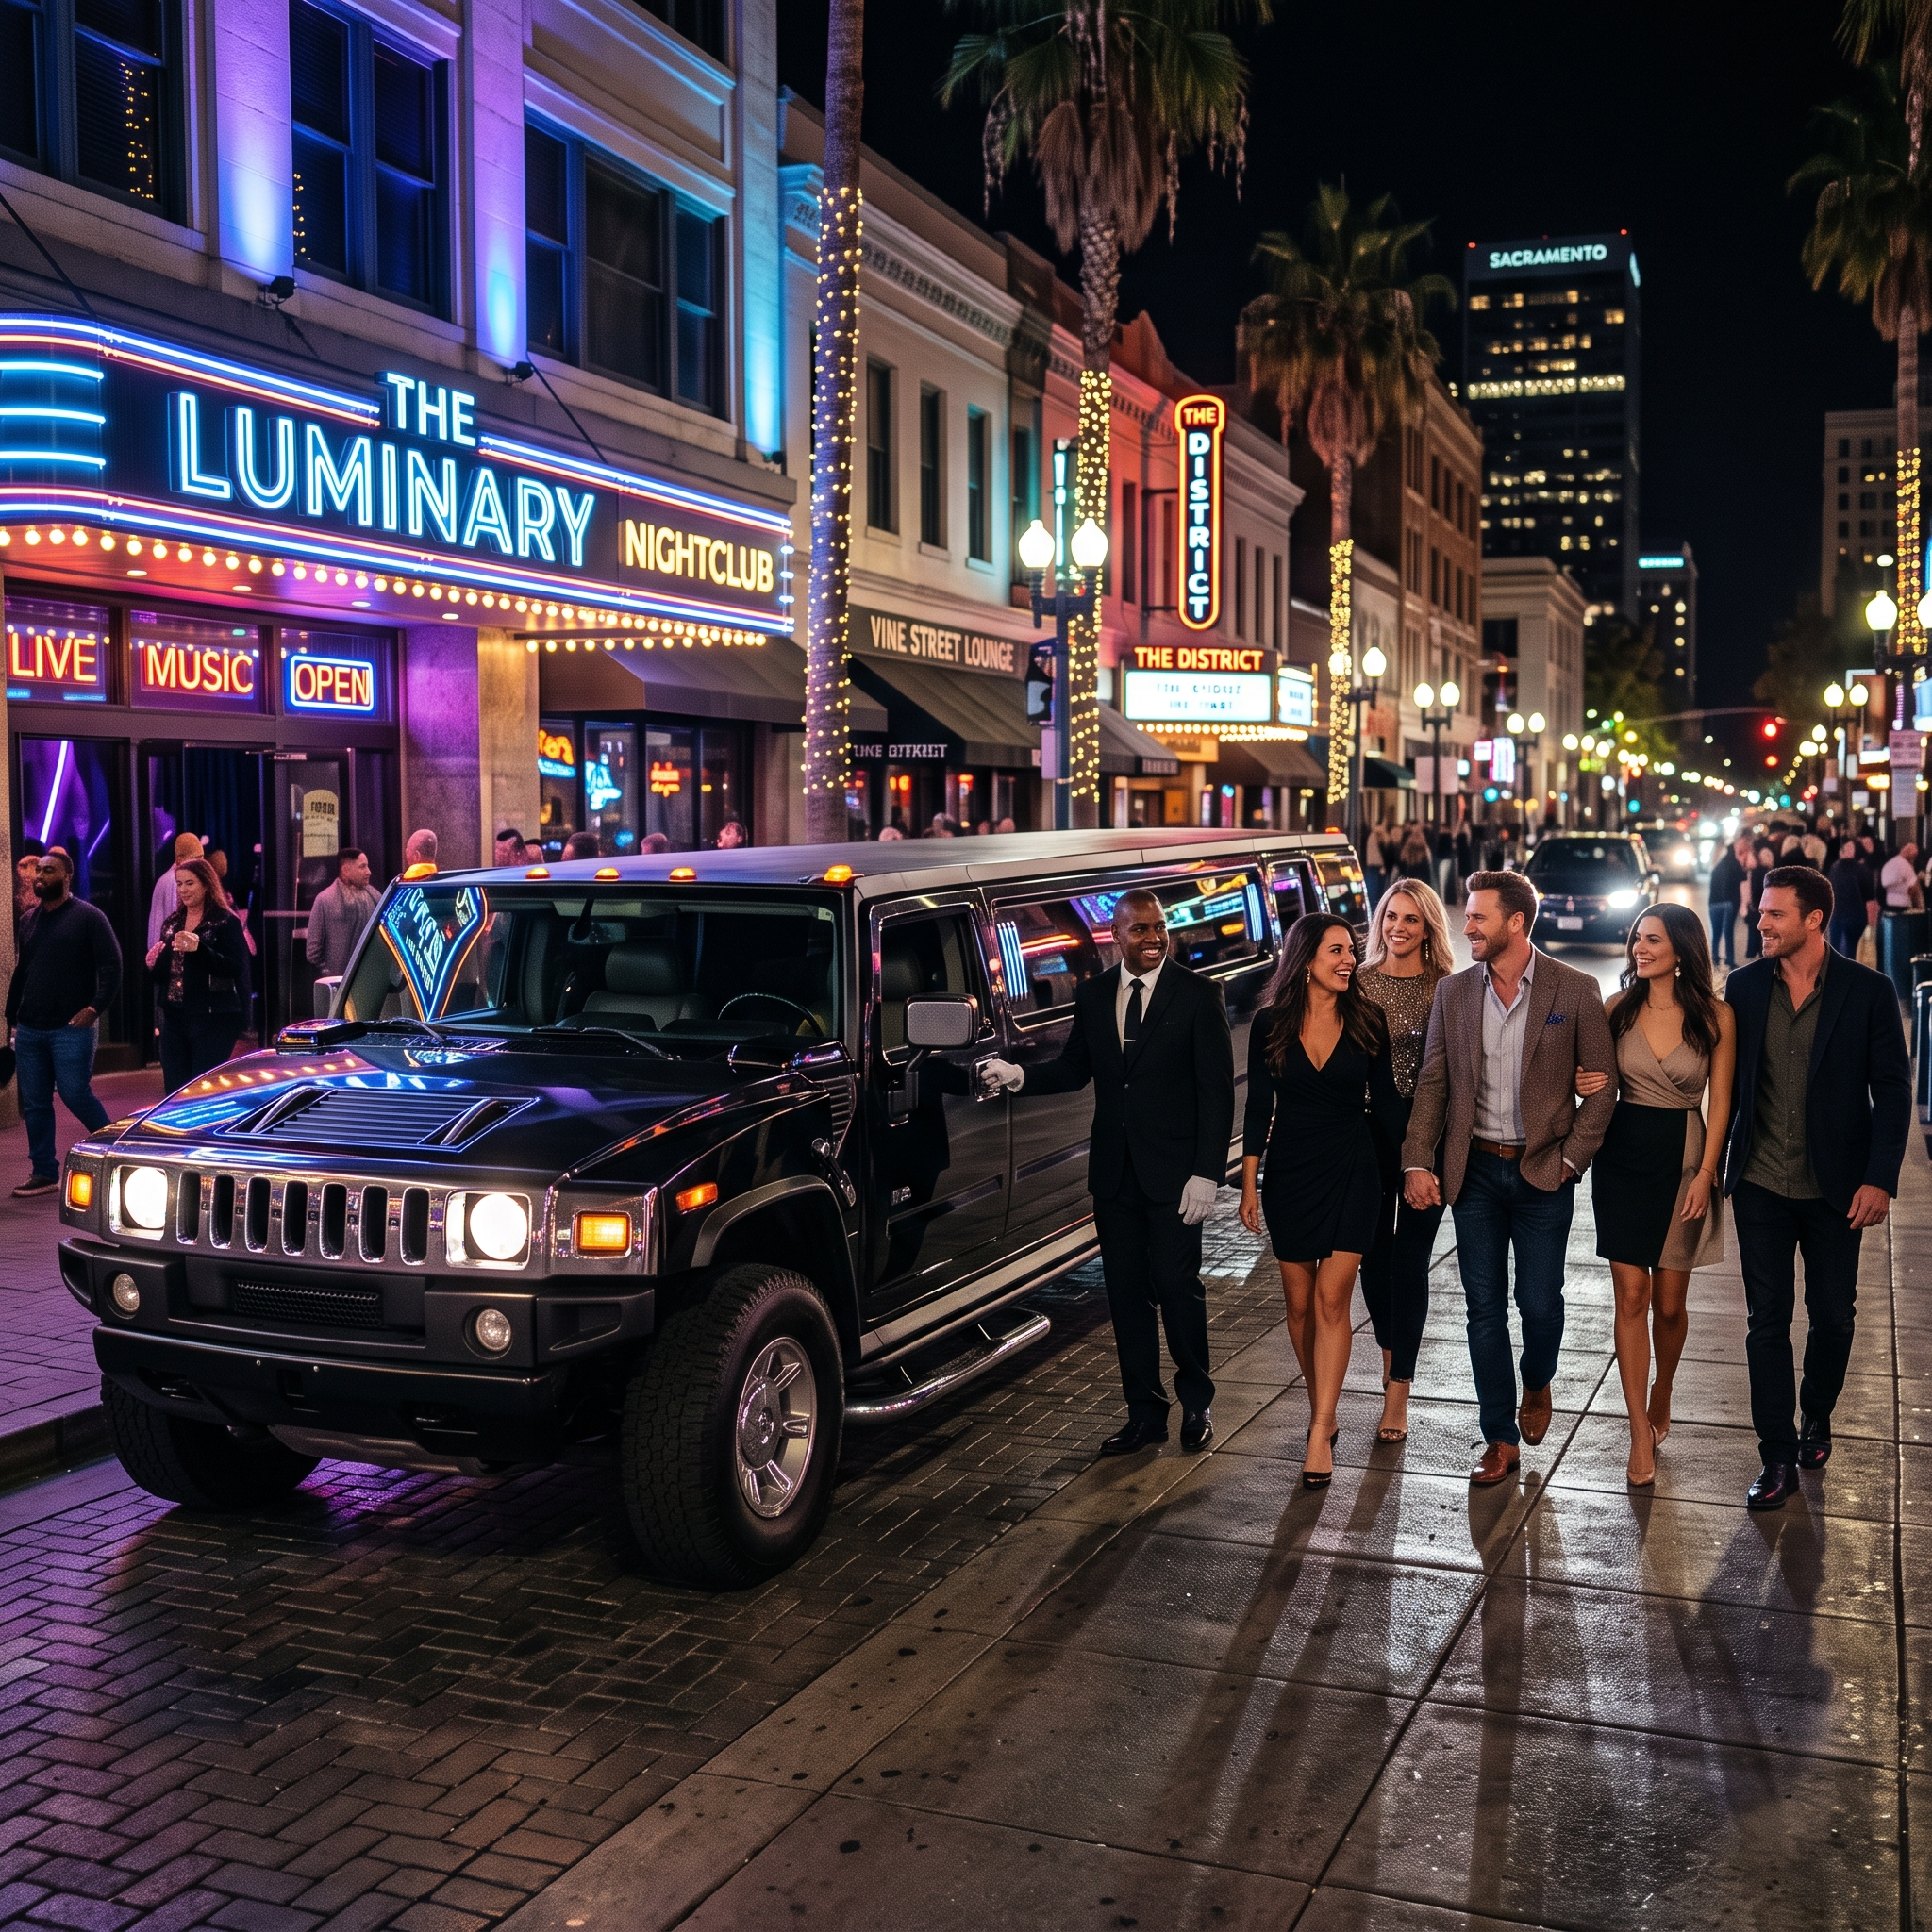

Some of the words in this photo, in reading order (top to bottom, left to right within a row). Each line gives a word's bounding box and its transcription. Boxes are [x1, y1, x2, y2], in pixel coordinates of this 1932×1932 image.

[1489, 244, 1607, 269] SACRAMENTO
[386, 372, 476, 447] THE
[1183, 407, 1217, 425] THE
[177, 390, 595, 567] LUMINARY
[1188, 432, 1211, 619] DISTRICT
[625, 519, 774, 593] NIGHTCLUB
[10, 632, 97, 682] LIVE
[144, 644, 254, 693] MUSIC
[870, 615, 908, 653] VINE
[910, 624, 961, 662] STREET
[964, 635, 1014, 672] LOUNGE
[1134, 646, 1174, 669] THE
[1177, 647, 1264, 672] DISTRICT
[294, 663, 371, 706] OPEN
